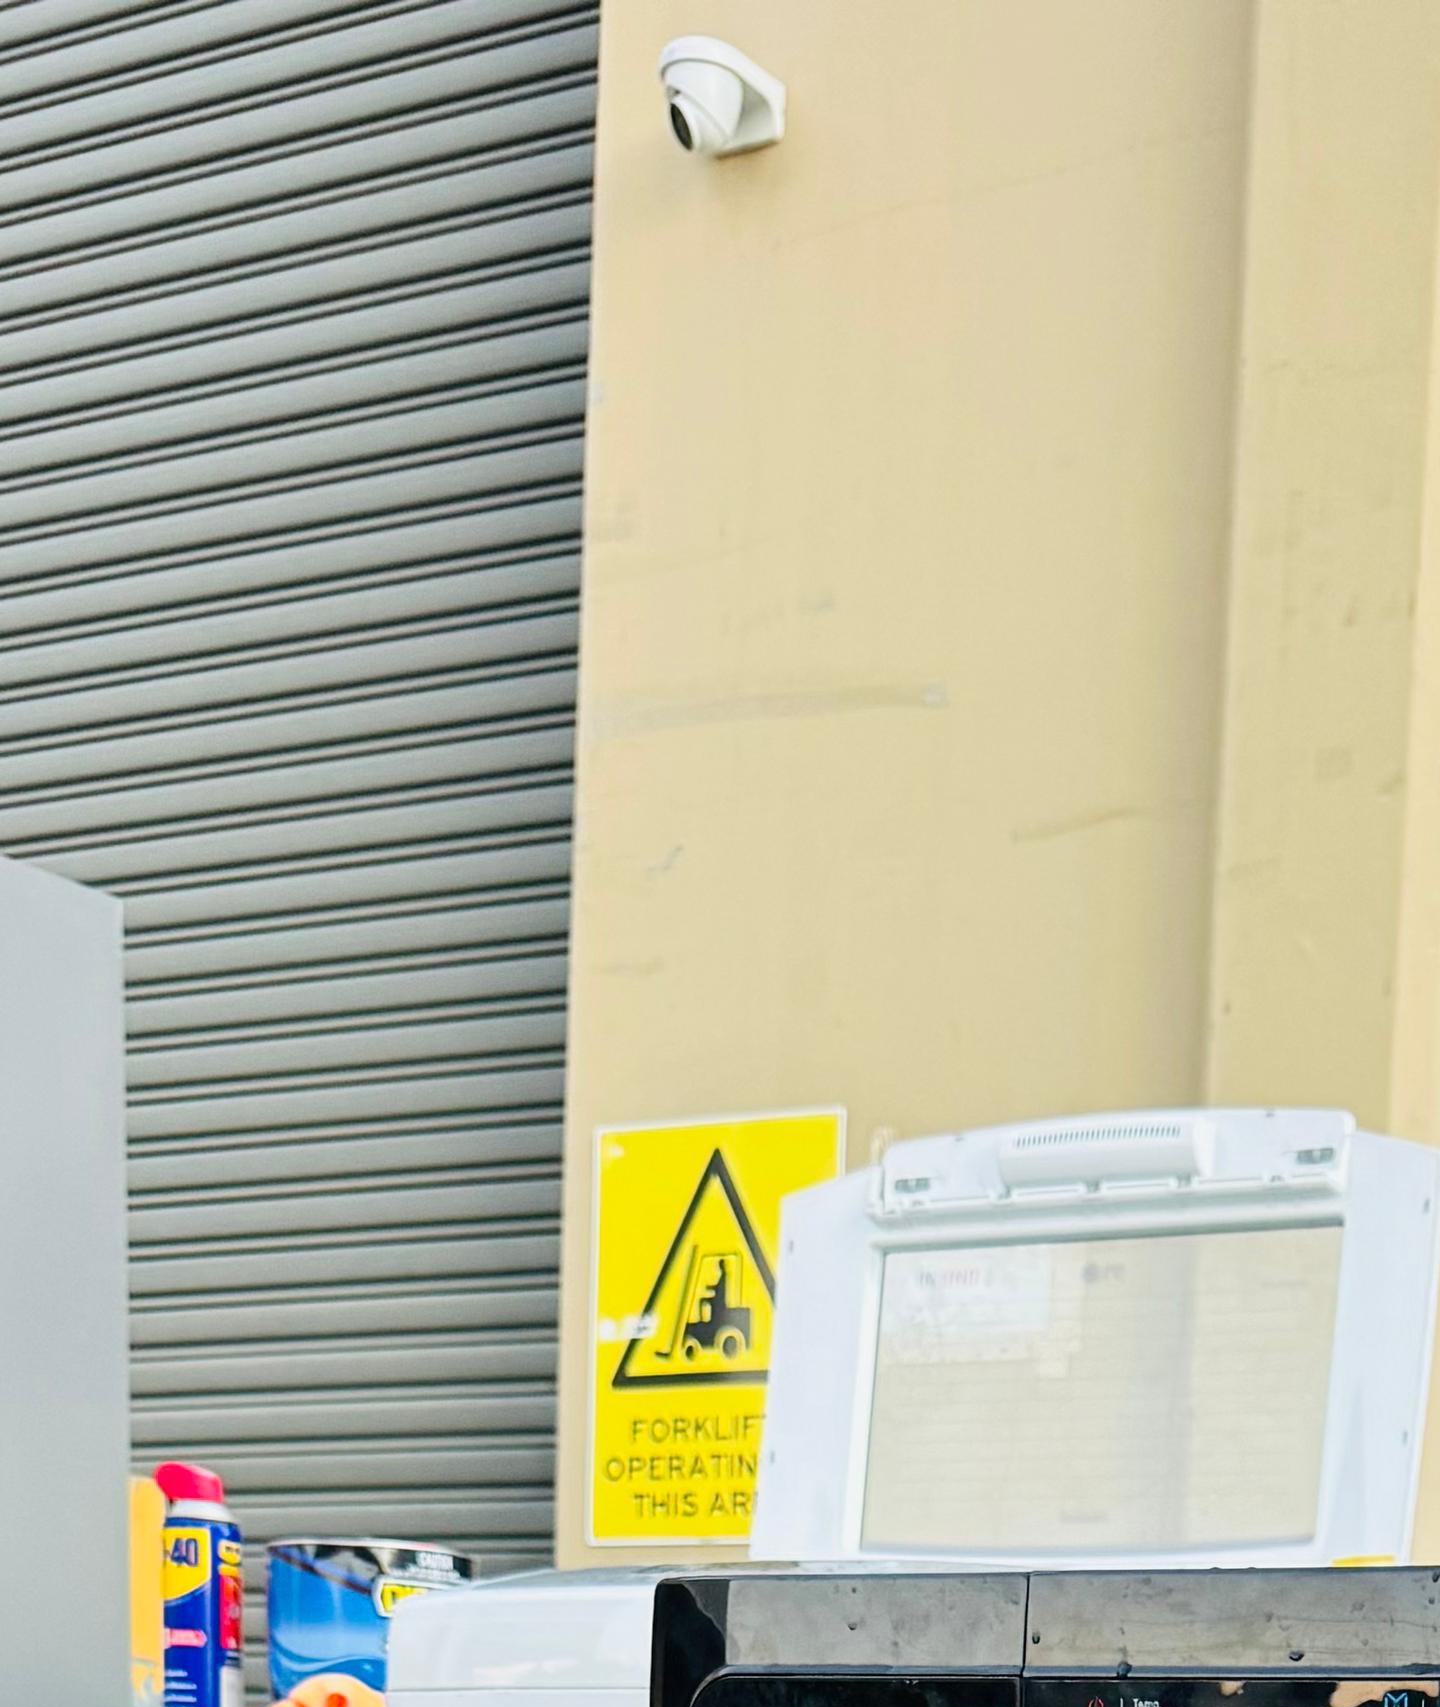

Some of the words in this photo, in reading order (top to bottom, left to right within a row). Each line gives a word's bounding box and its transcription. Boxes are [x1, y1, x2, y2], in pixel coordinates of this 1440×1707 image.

[605, 1454, 757, 1482] OPERATIN
[634, 1492, 699, 1518] THIS
[709, 1491, 758, 1517] AR
